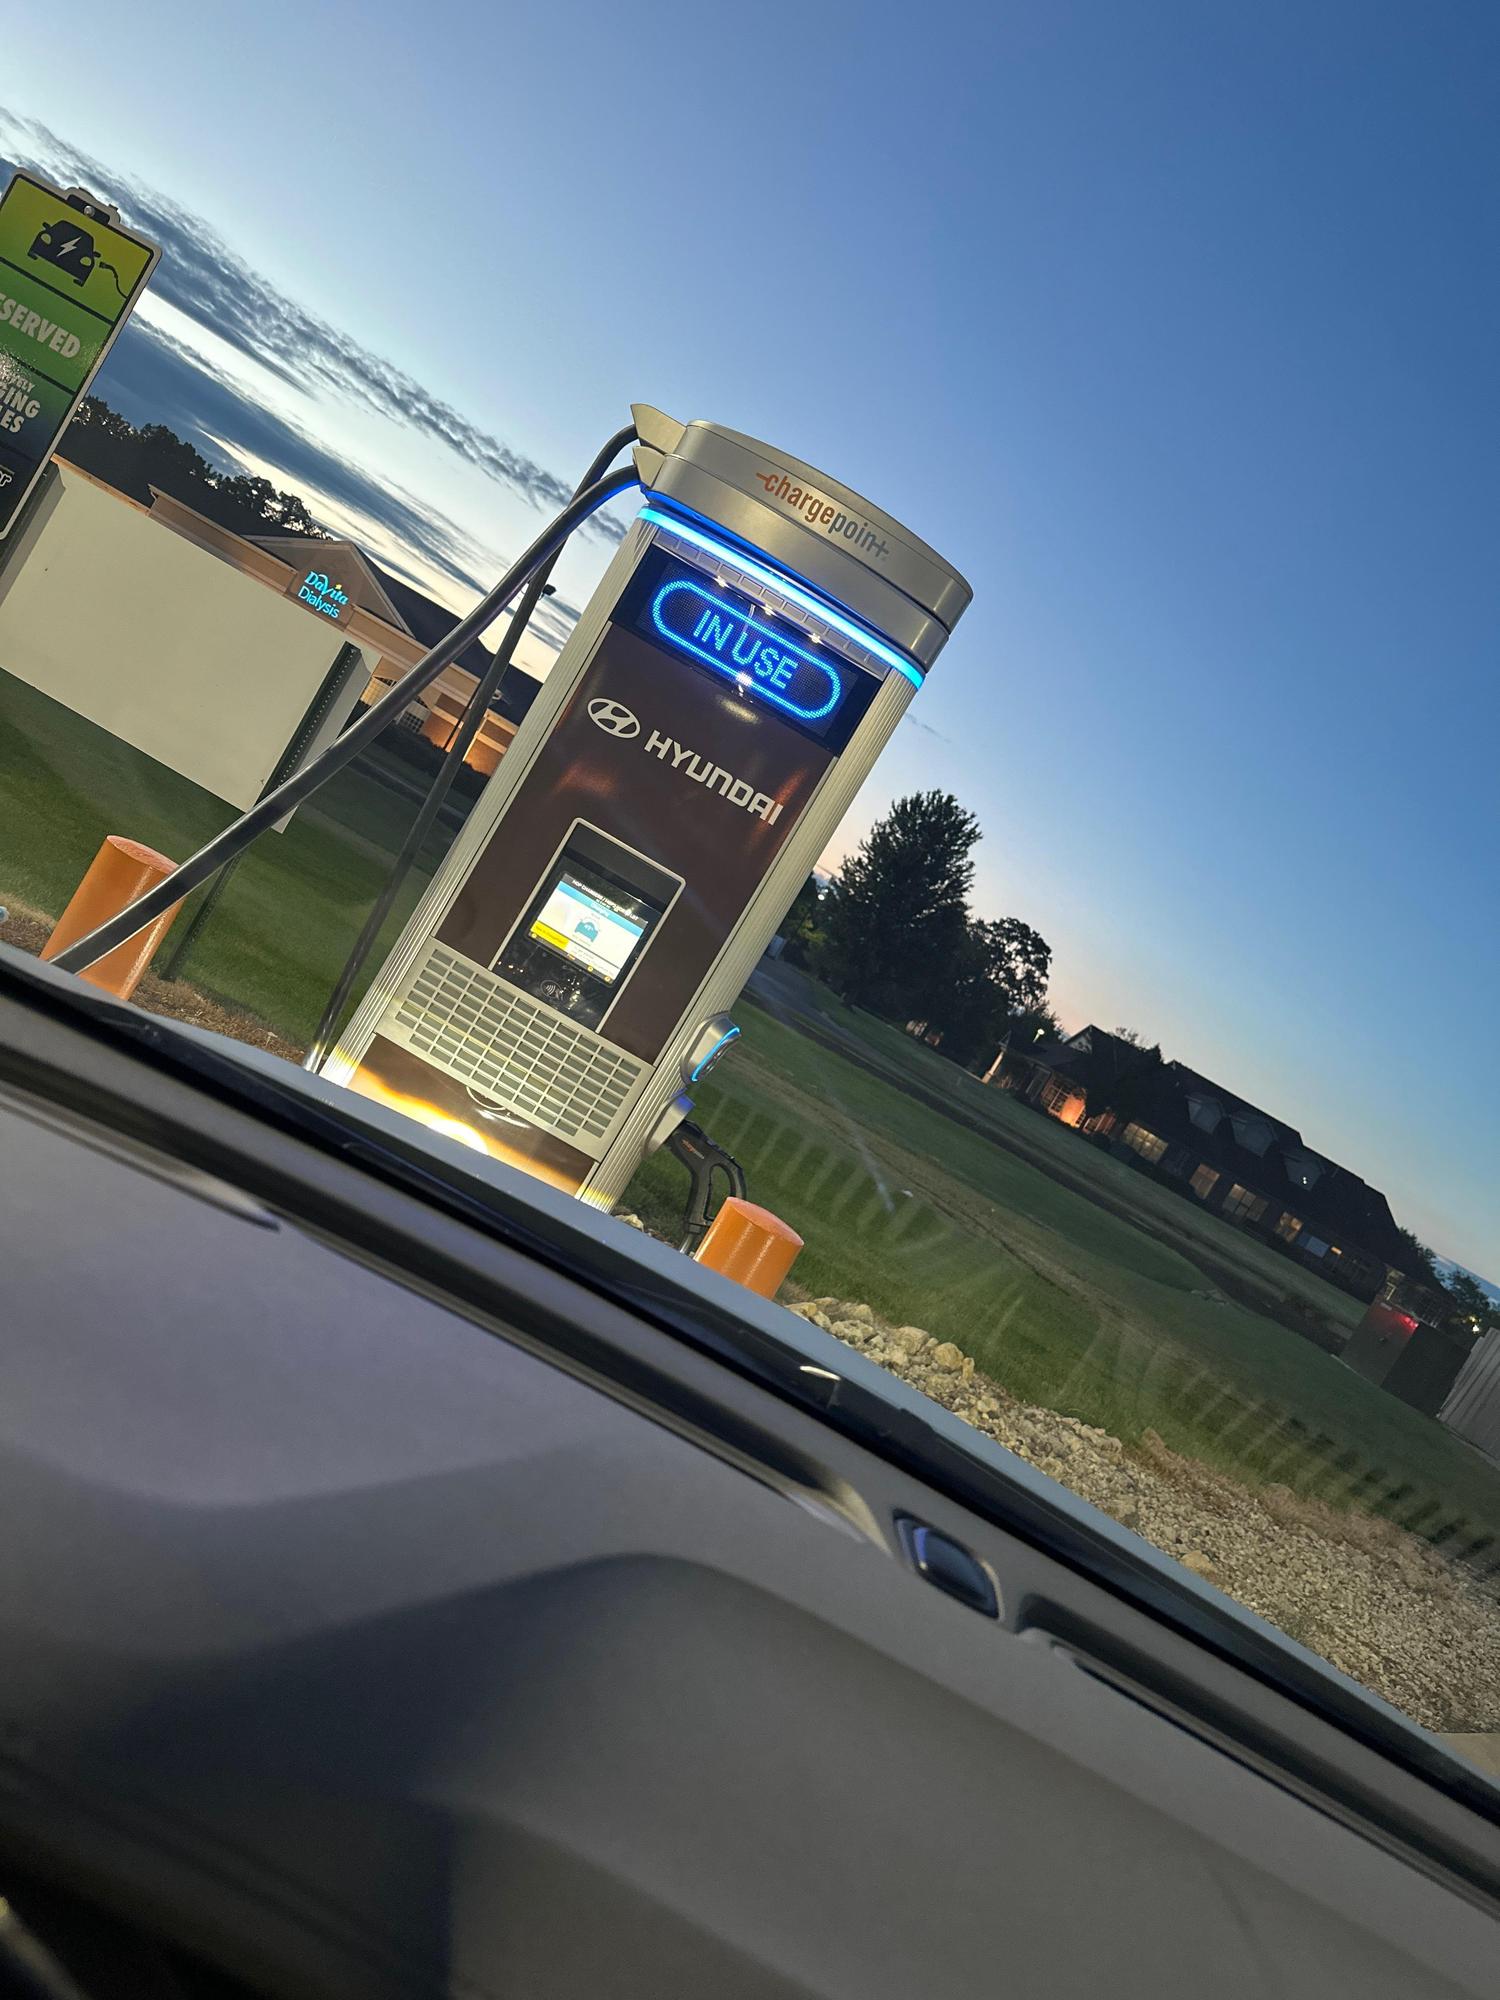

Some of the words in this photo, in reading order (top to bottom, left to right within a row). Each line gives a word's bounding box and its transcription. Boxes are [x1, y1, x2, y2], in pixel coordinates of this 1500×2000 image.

[756, 472, 890, 558] chargepoint
[298, 585, 340, 619] Dialysis
[304, 571, 349, 606] DaVita
[693, 609, 734, 652] IN
[732, 631, 799, 689] USE
[644, 729, 784, 826] HYUNDAI
